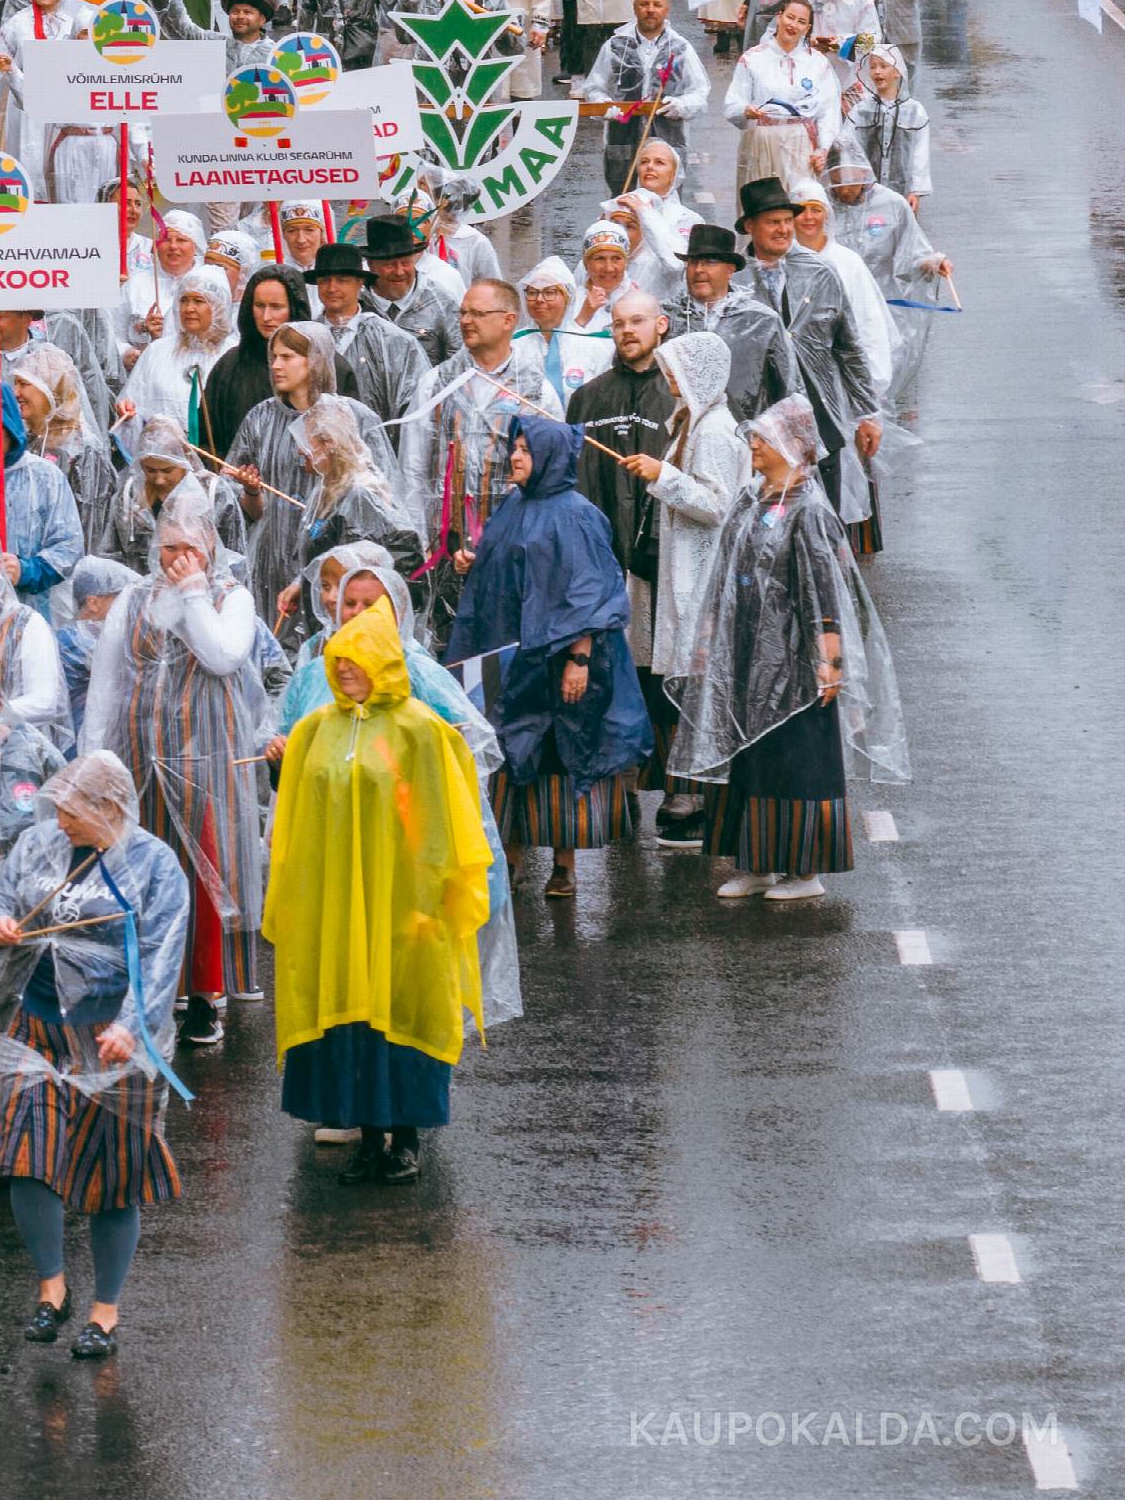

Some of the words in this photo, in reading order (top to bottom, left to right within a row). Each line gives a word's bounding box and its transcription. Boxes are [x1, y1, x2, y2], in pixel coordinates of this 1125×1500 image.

[67, 73, 183, 84] VÕIMLEMISRÜHM
[90, 92, 158, 110] ELLE
[178, 153, 218, 164] KUNDA
[220, 152, 254, 163] LINNA
[256, 152, 288, 162] KLUBI
[289, 150, 353, 161] SEGARÜHM
[174, 168, 360, 187] LAANETAGUSED
